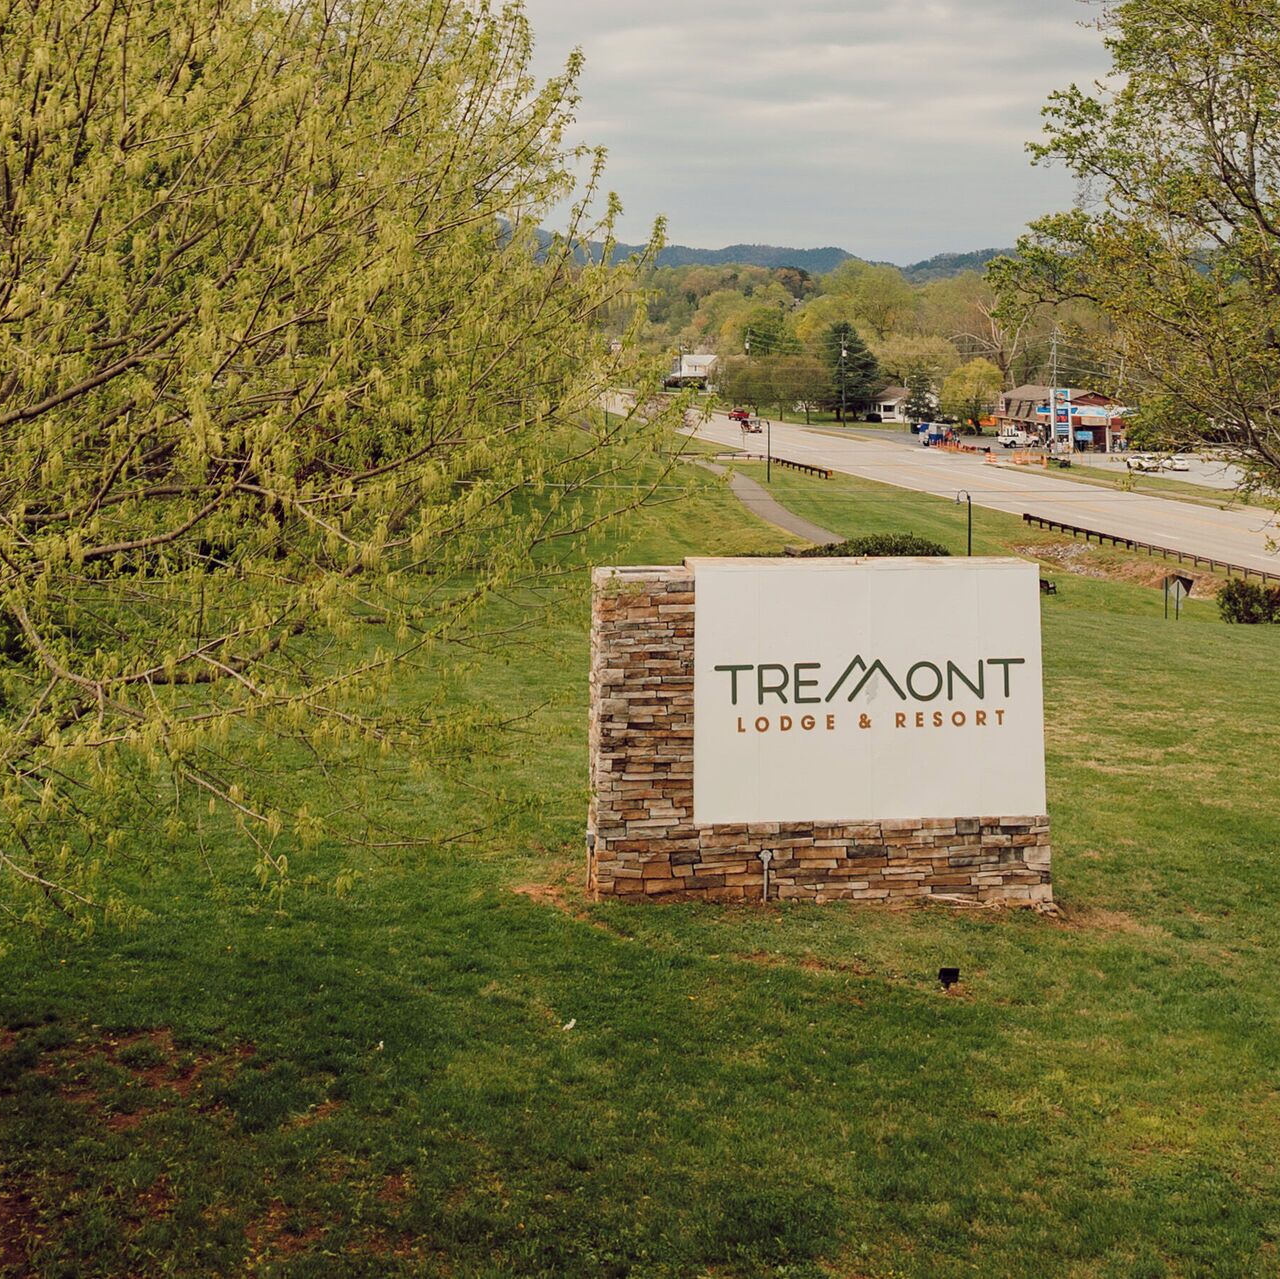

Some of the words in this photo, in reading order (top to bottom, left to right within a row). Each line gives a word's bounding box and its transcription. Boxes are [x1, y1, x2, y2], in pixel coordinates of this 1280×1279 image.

[714, 655, 1026, 706] TREMONT
[737, 713, 836, 734] LODGE
[858, 712, 873, 730] &
[895, 709, 1006, 729] RESORT
